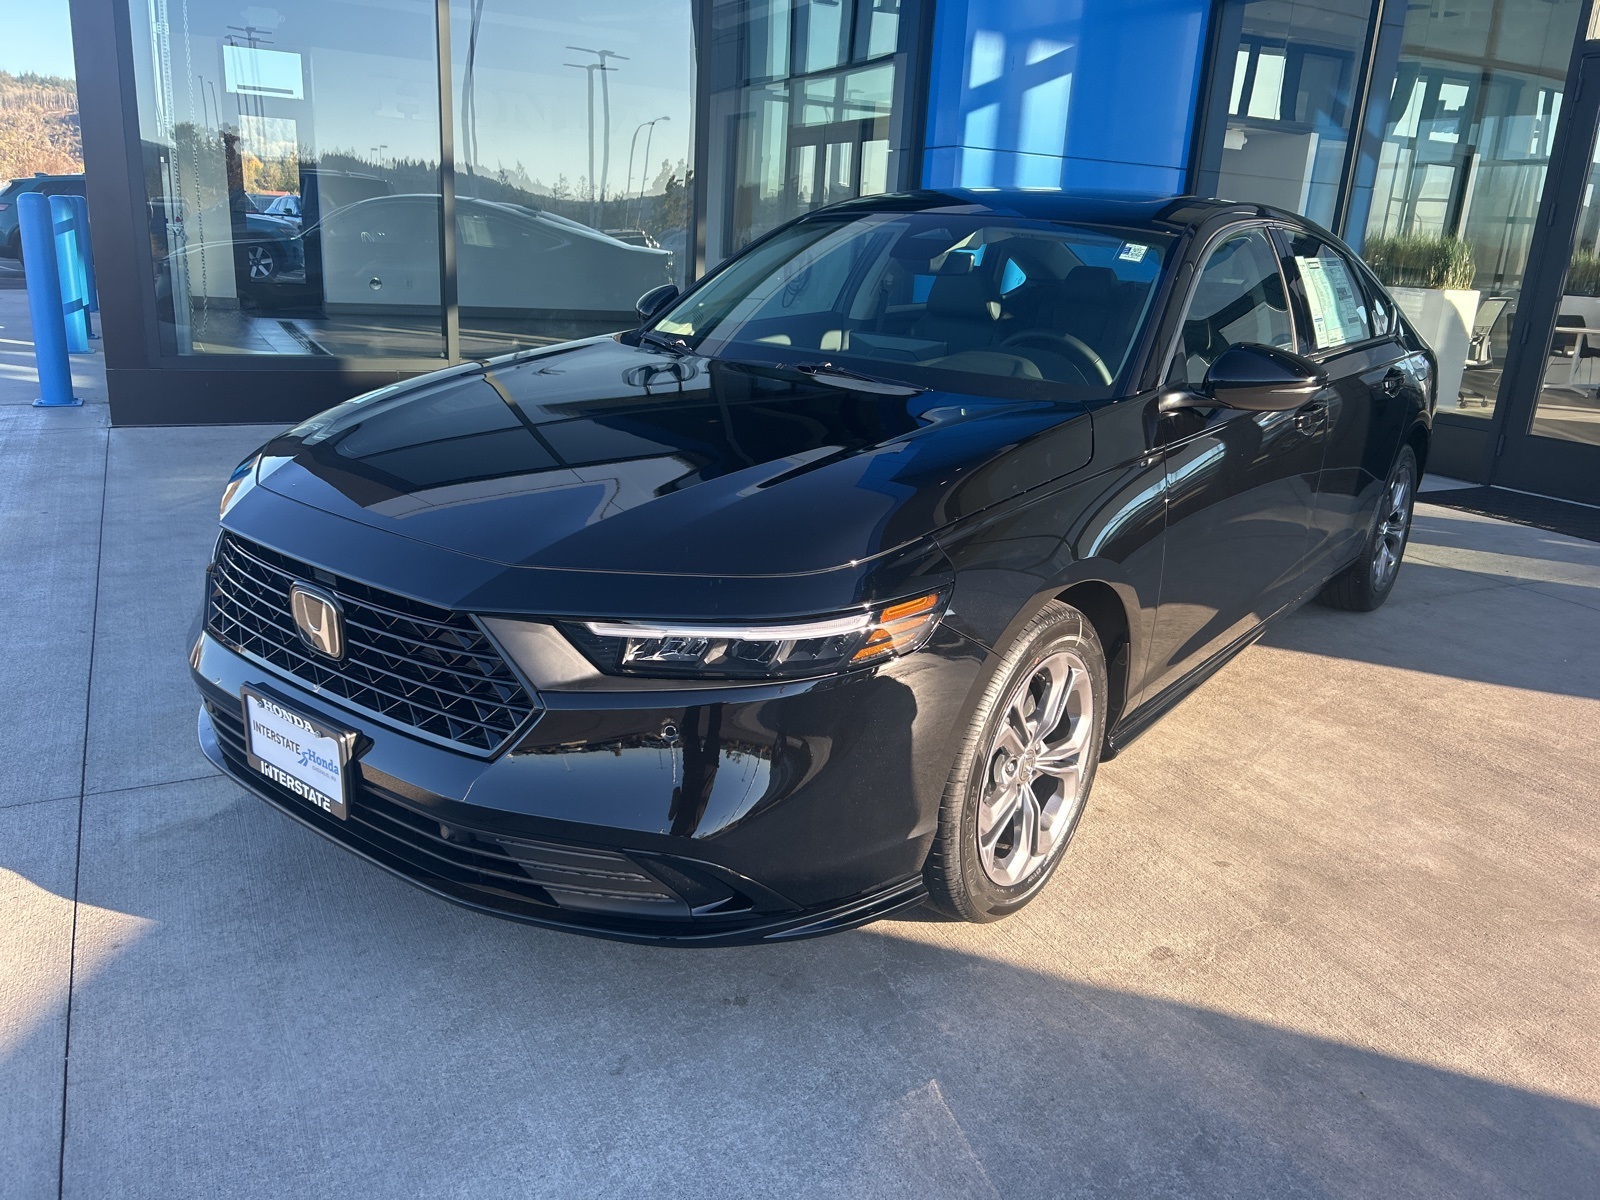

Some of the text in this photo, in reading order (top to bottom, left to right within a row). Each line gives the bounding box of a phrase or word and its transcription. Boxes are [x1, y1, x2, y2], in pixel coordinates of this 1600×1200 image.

[262, 698, 316, 734] HONDA
[253, 720, 301, 755] INTERSTATE
[307, 748, 339, 775] Honda
[260, 760, 331, 813] INTERSTATE
